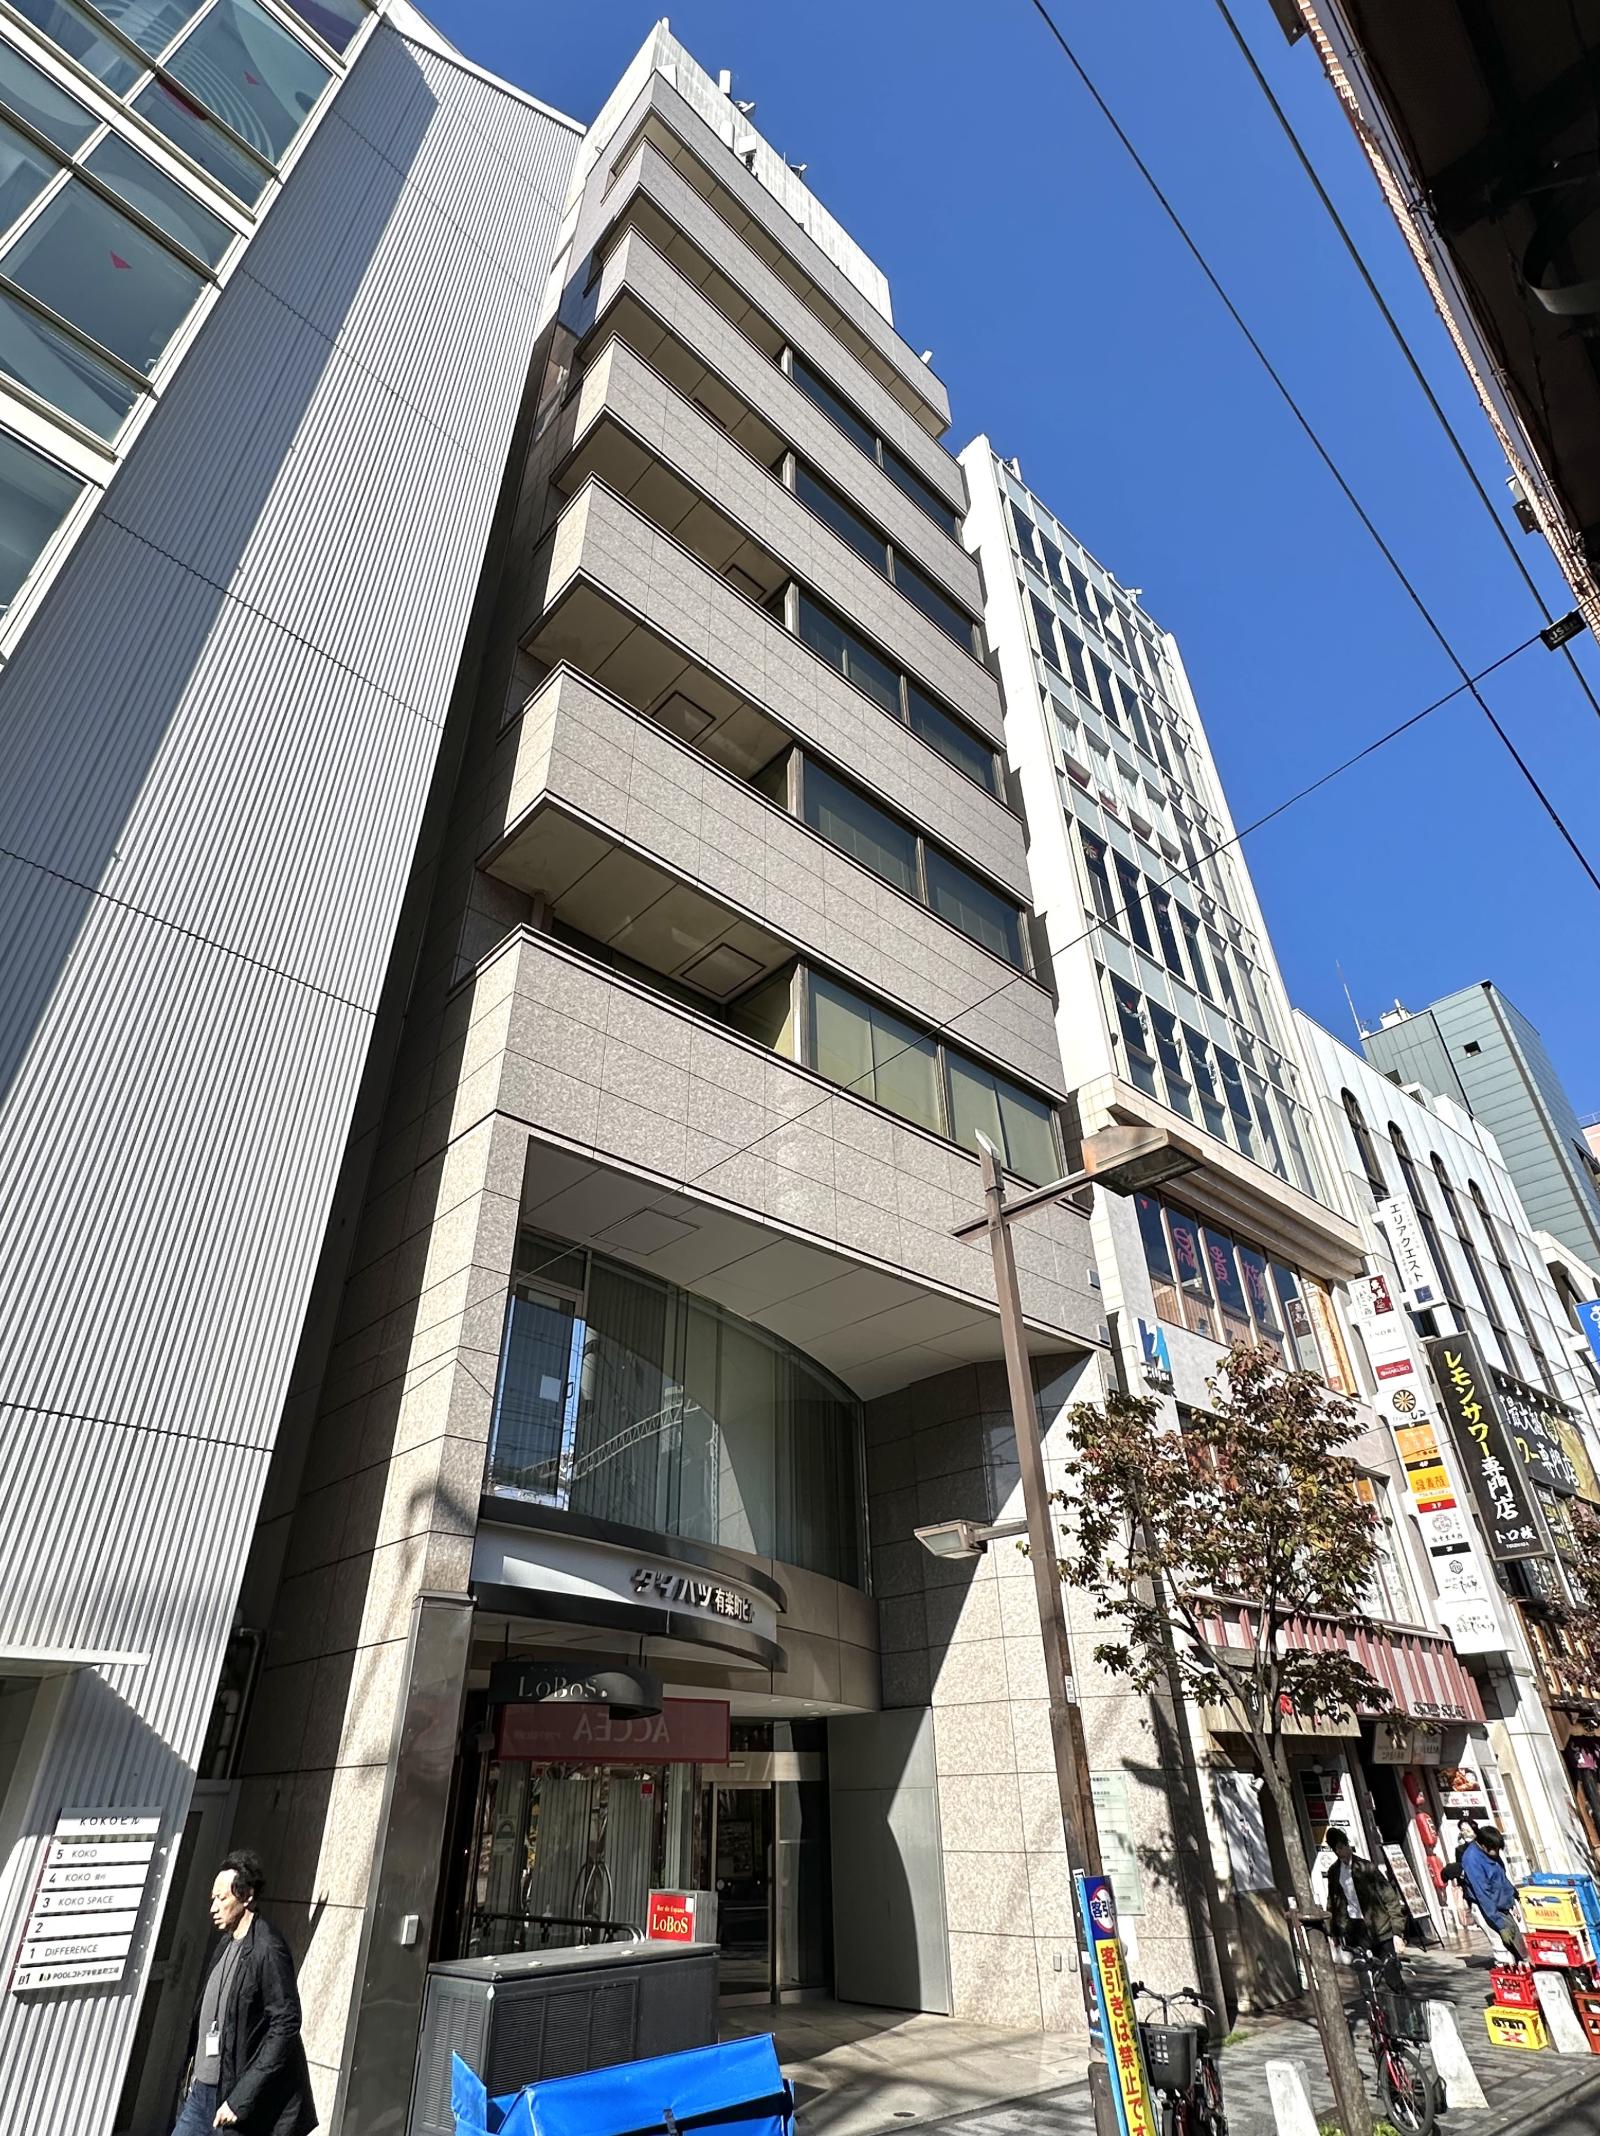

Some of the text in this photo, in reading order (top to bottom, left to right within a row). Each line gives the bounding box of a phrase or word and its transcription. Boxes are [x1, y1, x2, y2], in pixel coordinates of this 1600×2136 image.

[1390, 1203, 1423, 1282] エリアクエスト
[1444, 1350, 1519, 1521] レモンサワー専門店
[56, 1849, 98, 1860] 5 KOKO
[49, 1873, 57, 1884] 4
[65, 1873, 91, 1882] KOKO
[42, 1896, 114, 1908] 3 KOKO SPACE
[35, 1922, 43, 1933] 2
[652, 1914, 689, 1934] LoBoS
[30, 1944, 99, 1959] 1 DIFFERENCE
